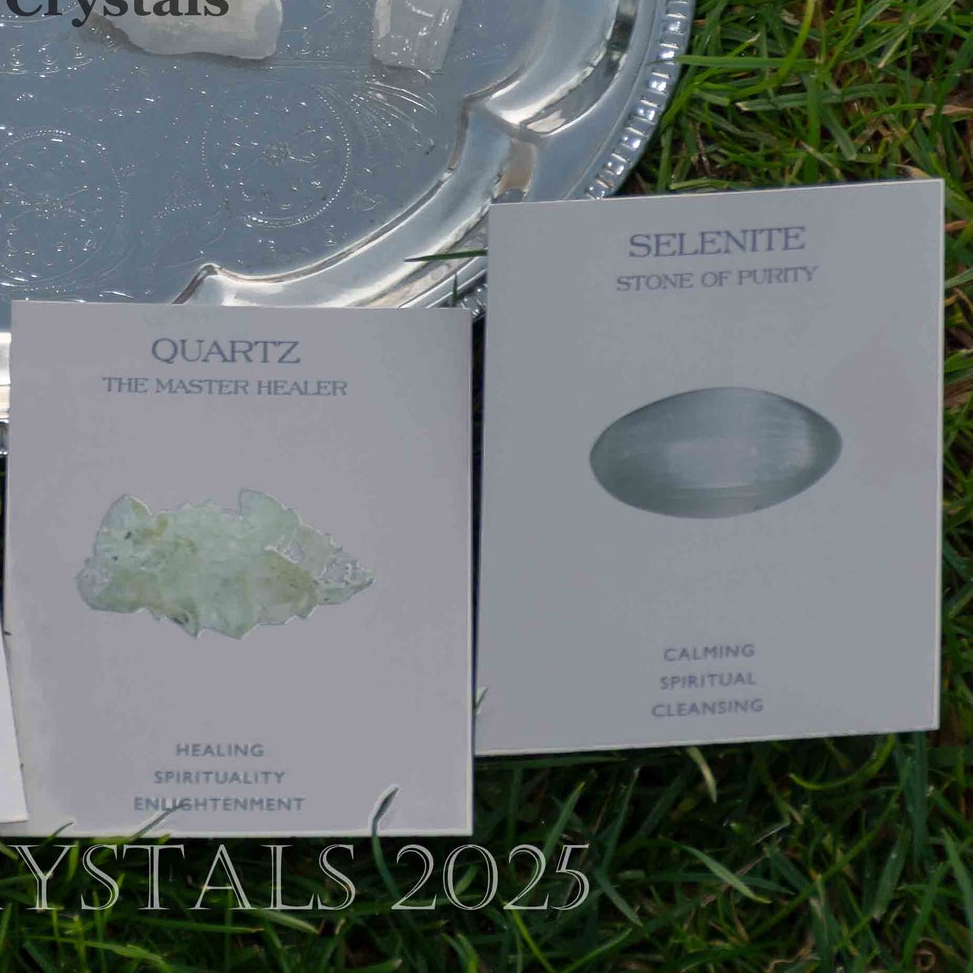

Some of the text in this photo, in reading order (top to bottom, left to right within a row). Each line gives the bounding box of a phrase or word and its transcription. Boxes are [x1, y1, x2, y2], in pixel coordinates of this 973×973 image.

[628, 226, 805, 258] SELENITE
[616, 266, 818, 292] STONE OF PURITY
[151, 338, 301, 365] QUARTZ
[102, 377, 347, 396] THE MASTER HEALER
[663, 643, 755, 662] CALMING
[659, 671, 756, 690] SPIRITUAL
[651, 698, 763, 719] CLEANSING
[176, 743, 264, 758] HEALING
[154, 770, 285, 786] SPIRITUALITY
[133, 797, 305, 812] ENLIGHTENMENT
